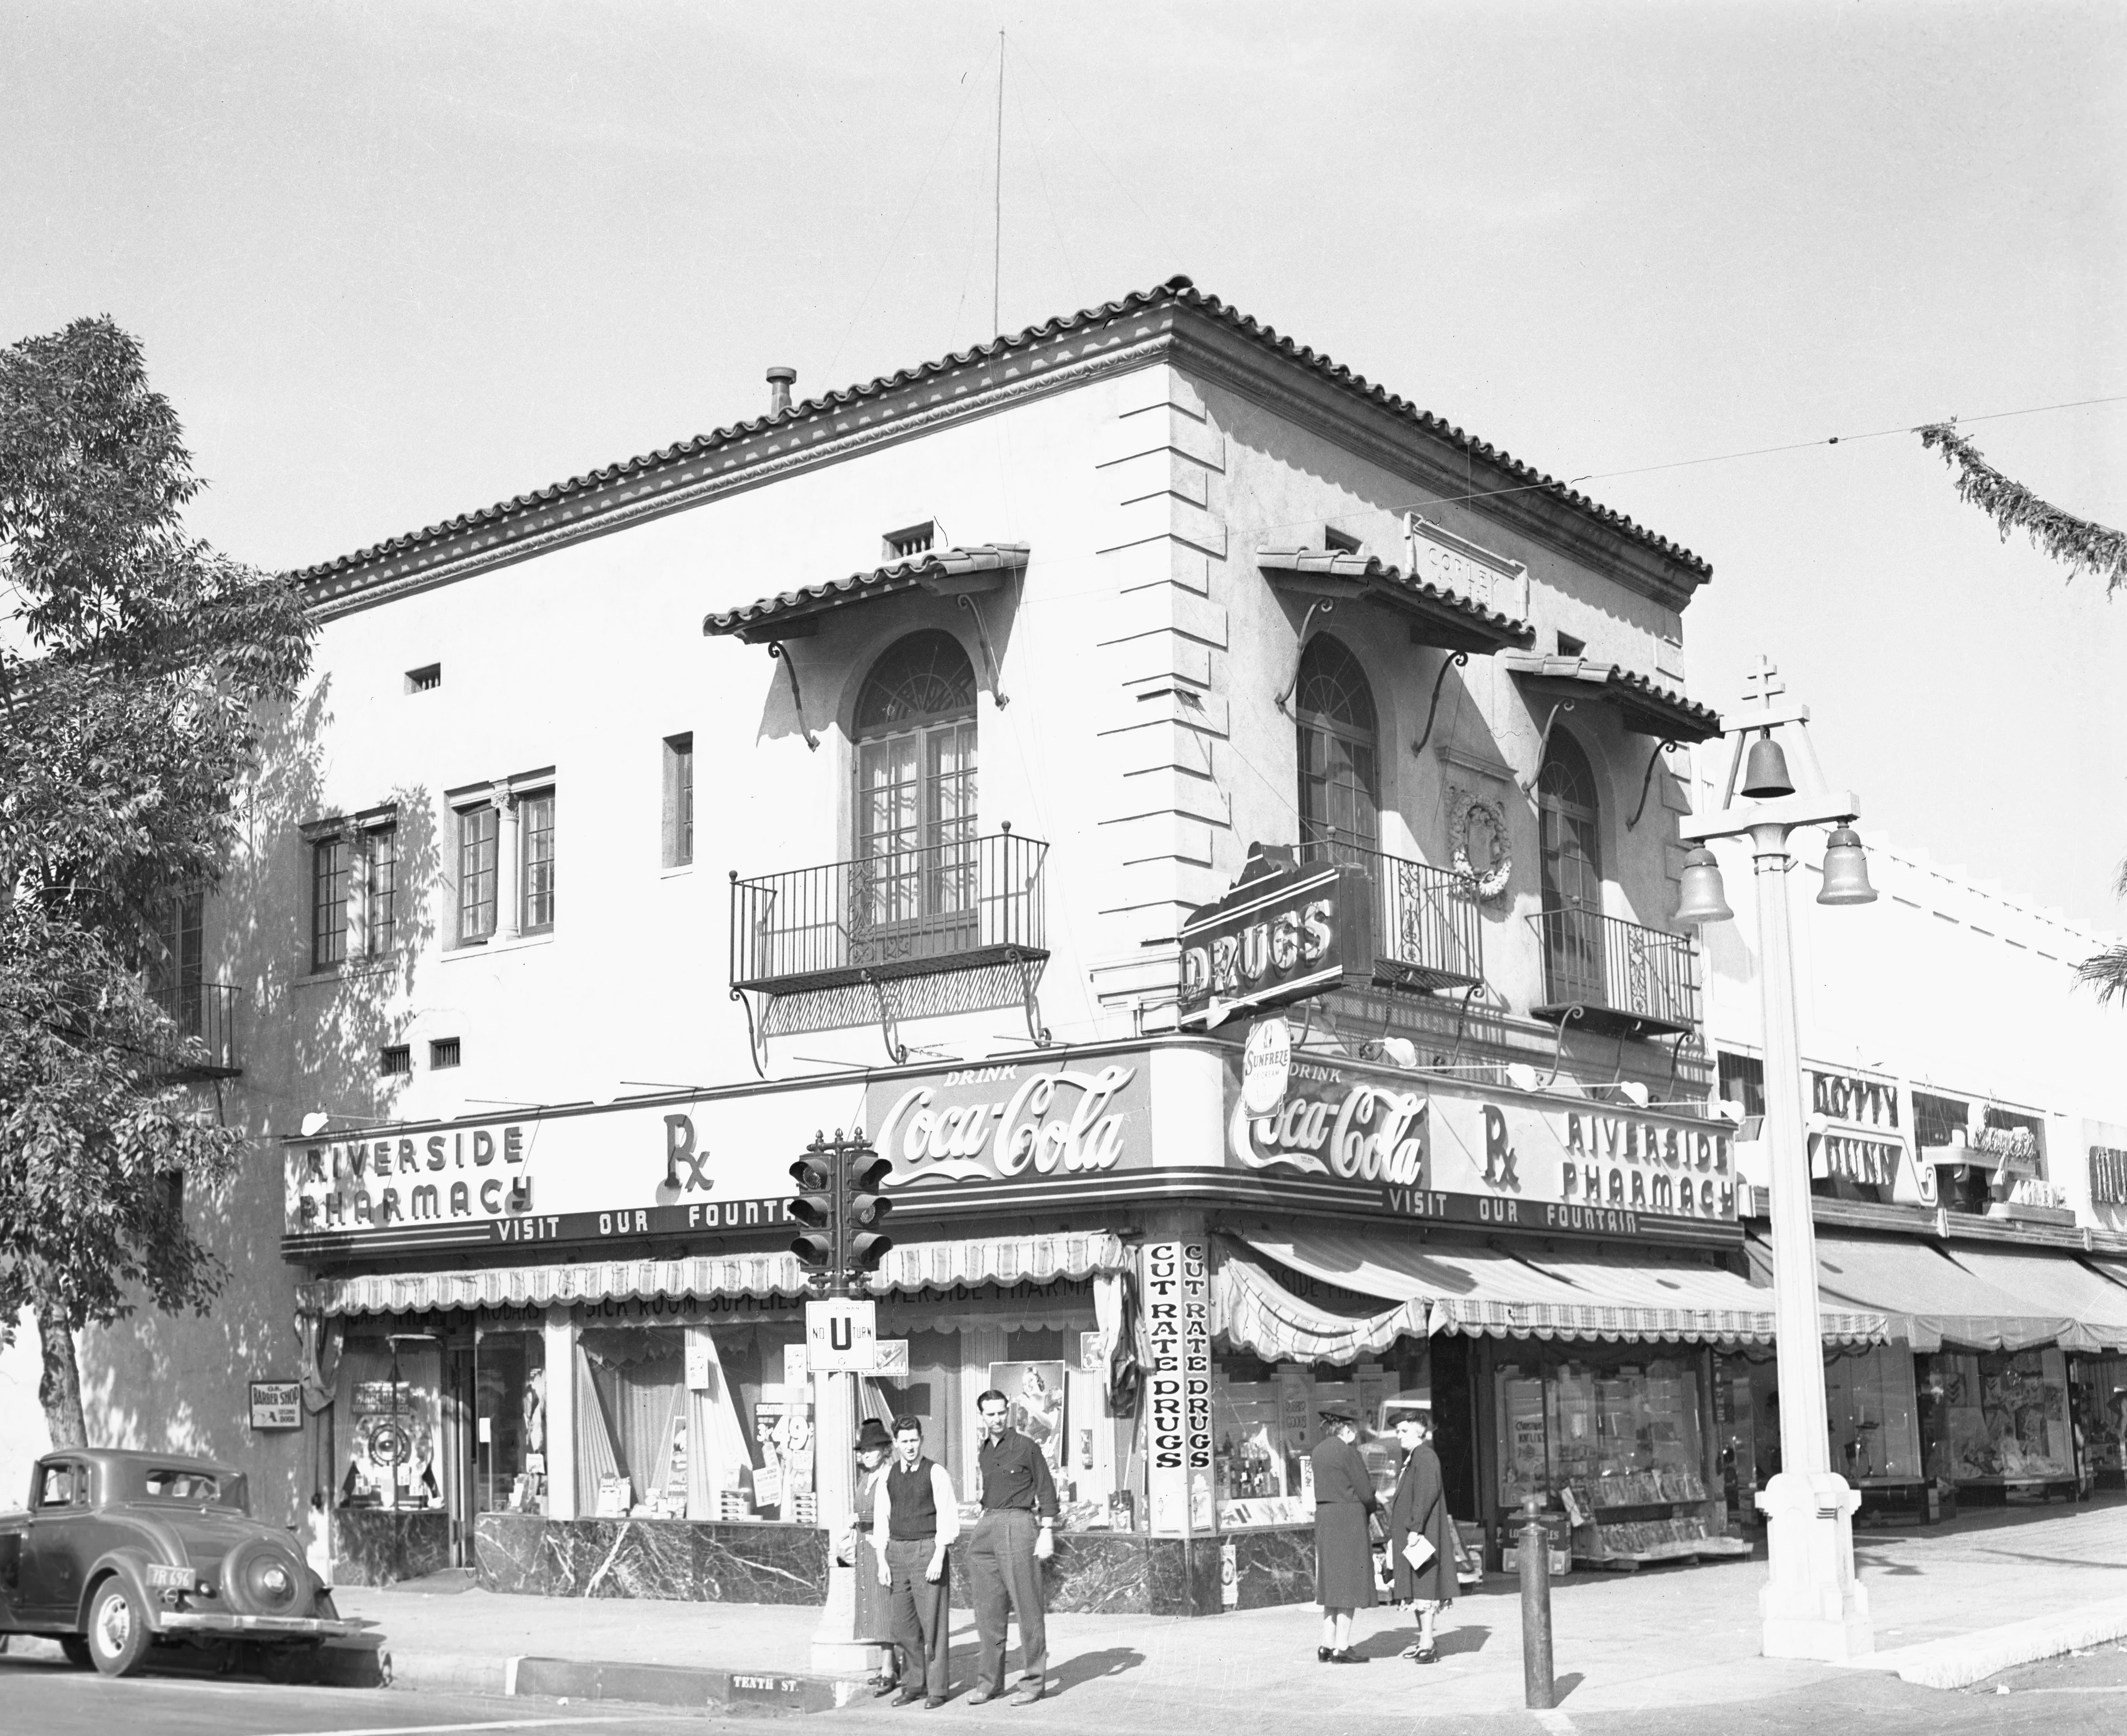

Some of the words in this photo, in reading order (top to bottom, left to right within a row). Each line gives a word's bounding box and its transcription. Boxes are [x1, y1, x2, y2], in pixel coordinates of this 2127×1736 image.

[1180, 899, 1330, 1008] DRUGS
[944, 1065, 1019, 1087] DRINK
[1261, 1069, 1280, 1079] CREAM
[1289, 1064, 1341, 1084] DRINK
[874, 1065, 1137, 1185] Coca-Cola
[1563, 1111, 1729, 1175] RIVERSIDE
[307, 1126, 524, 1183] RIVERSIDE
[300, 1176, 535, 1228] PHARMACY
[1388, 1188, 1447, 1216] VISIT
[1479, 1198, 1517, 1223] OUR
[1547, 1204, 1636, 1234] FOUNTAIN
[1558, 1161, 1734, 1216] PHARMACY
[496, 1217, 559, 1241] VISIT
[599, 1210, 648, 1234] OUR
[689, 1198, 797, 1227] FOUNTA
[1150, 1245, 1177, 1296] CUT
[1184, 1245, 1205, 1296] CUT
[813, 1328, 824, 1339] NO
[830, 1317, 852, 1350] U
[853, 1327, 872, 1339] TURN
[1151, 1303, 1178, 1372] RATE
[1185, 1303, 1207, 1371] RATE
[253, 1386, 278, 1405] BARBER
[280, 1386, 299, 1405] SHOP
[1153, 1380, 1183, 1468] DRUGS
[1188, 1380, 1210, 1468] DRUGS
[170, 1570, 189, 1587] 696
[733, 1677, 773, 1690] TENTH
[781, 1680, 799, 1692] ST.
